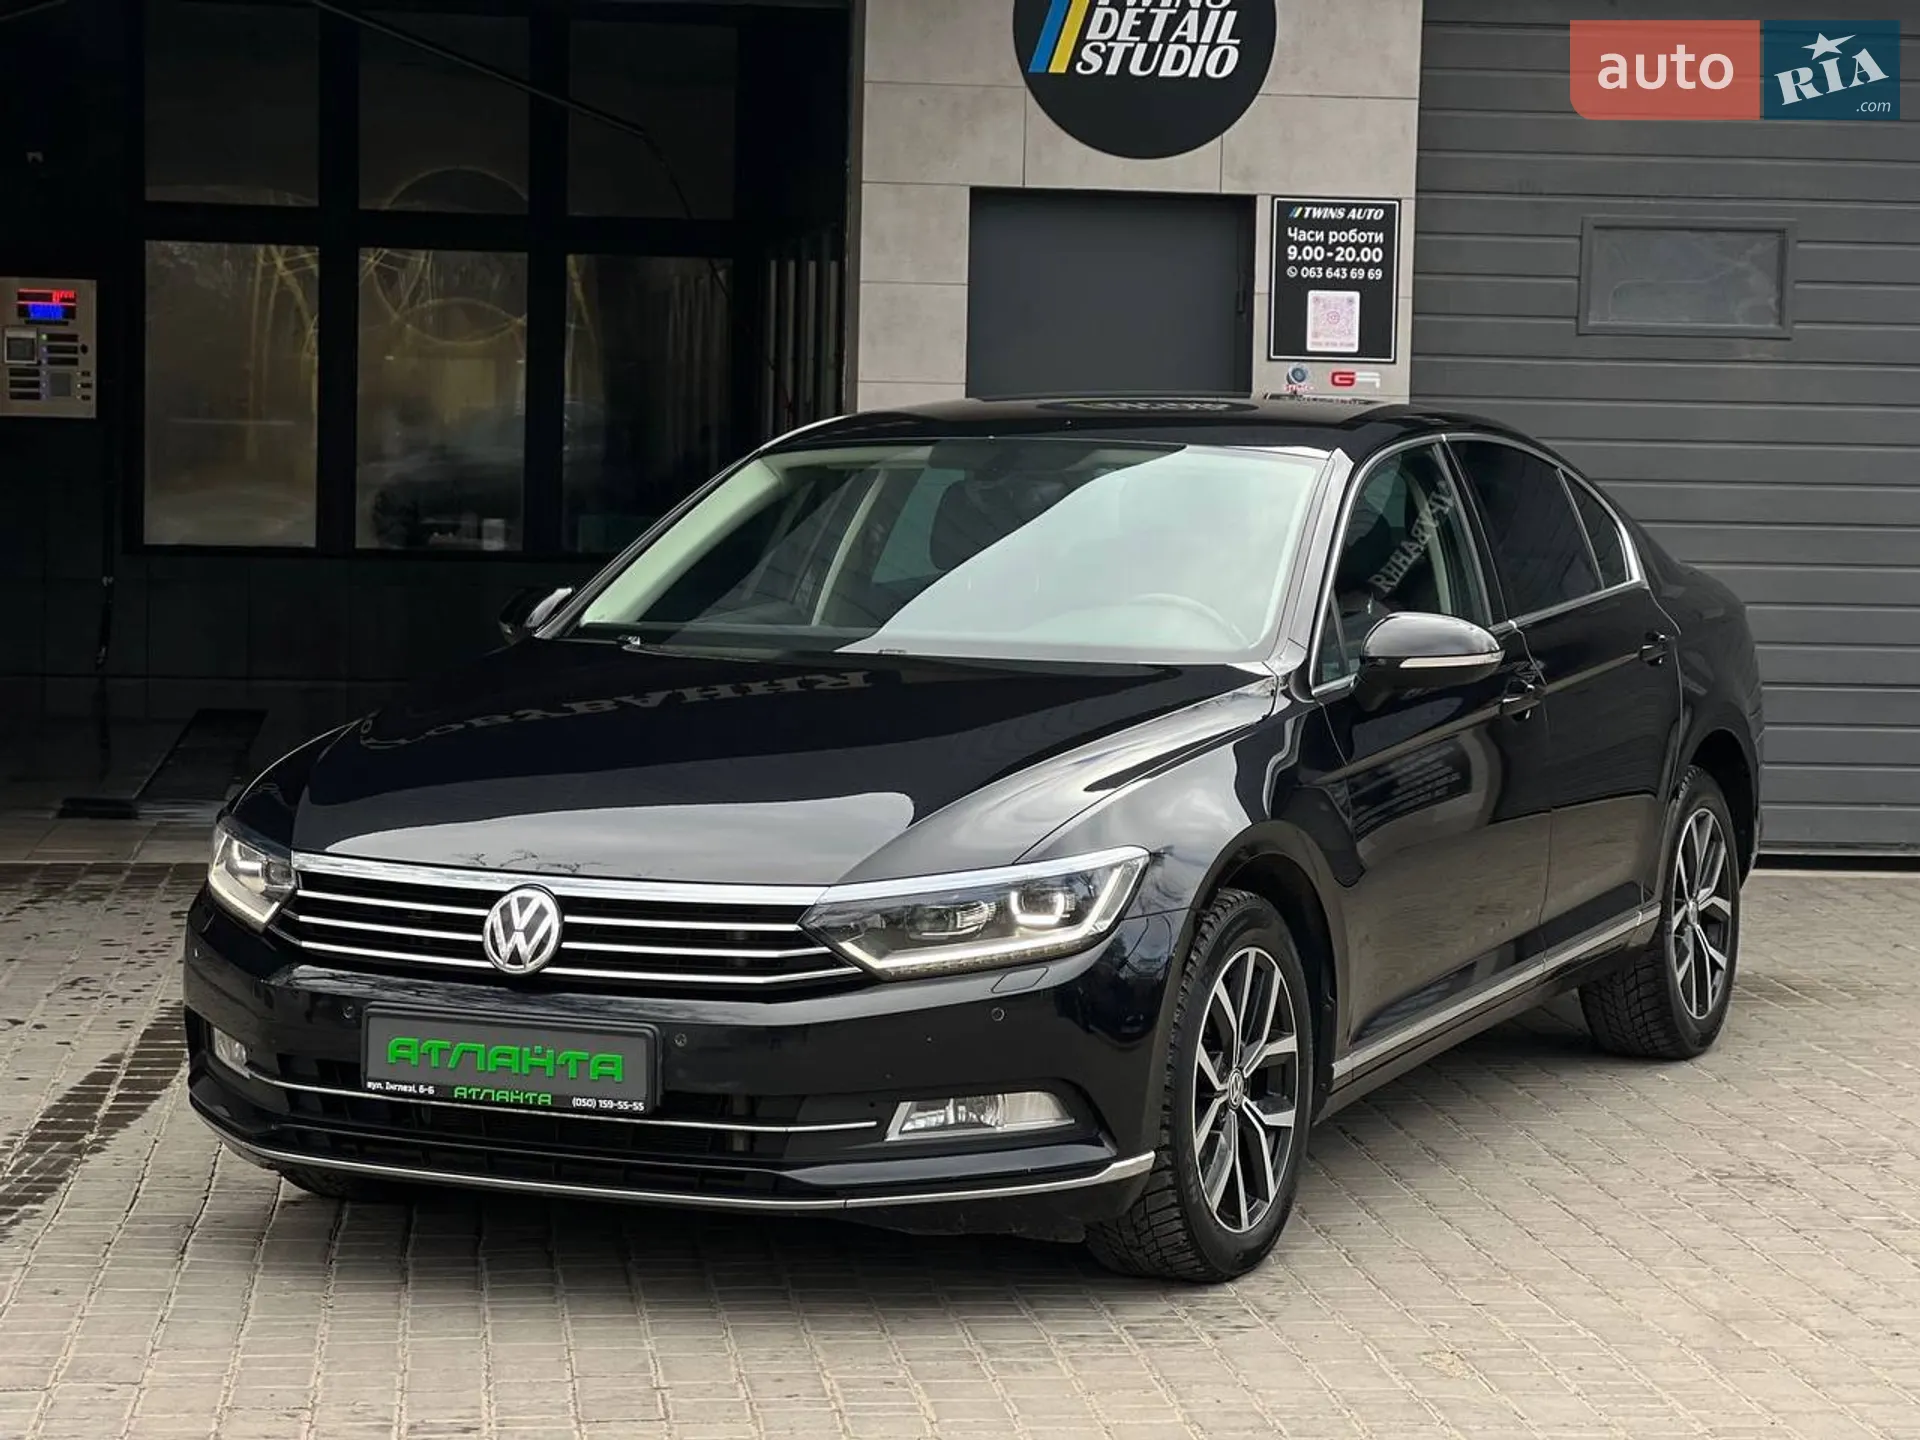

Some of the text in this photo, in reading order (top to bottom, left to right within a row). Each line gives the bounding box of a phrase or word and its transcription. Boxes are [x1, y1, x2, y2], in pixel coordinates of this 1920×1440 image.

[1086, 7, 1241, 45] DETAIL
[1075, 41, 1239, 79] STUDIO
[1303, 206, 1385, 221] TWINS AUTO
[1286, 227, 1384, 244] Часи роботи
[1300, 267, 1383, 281] 063 643 69 69
[571, 1096, 597, 1109] (050)
